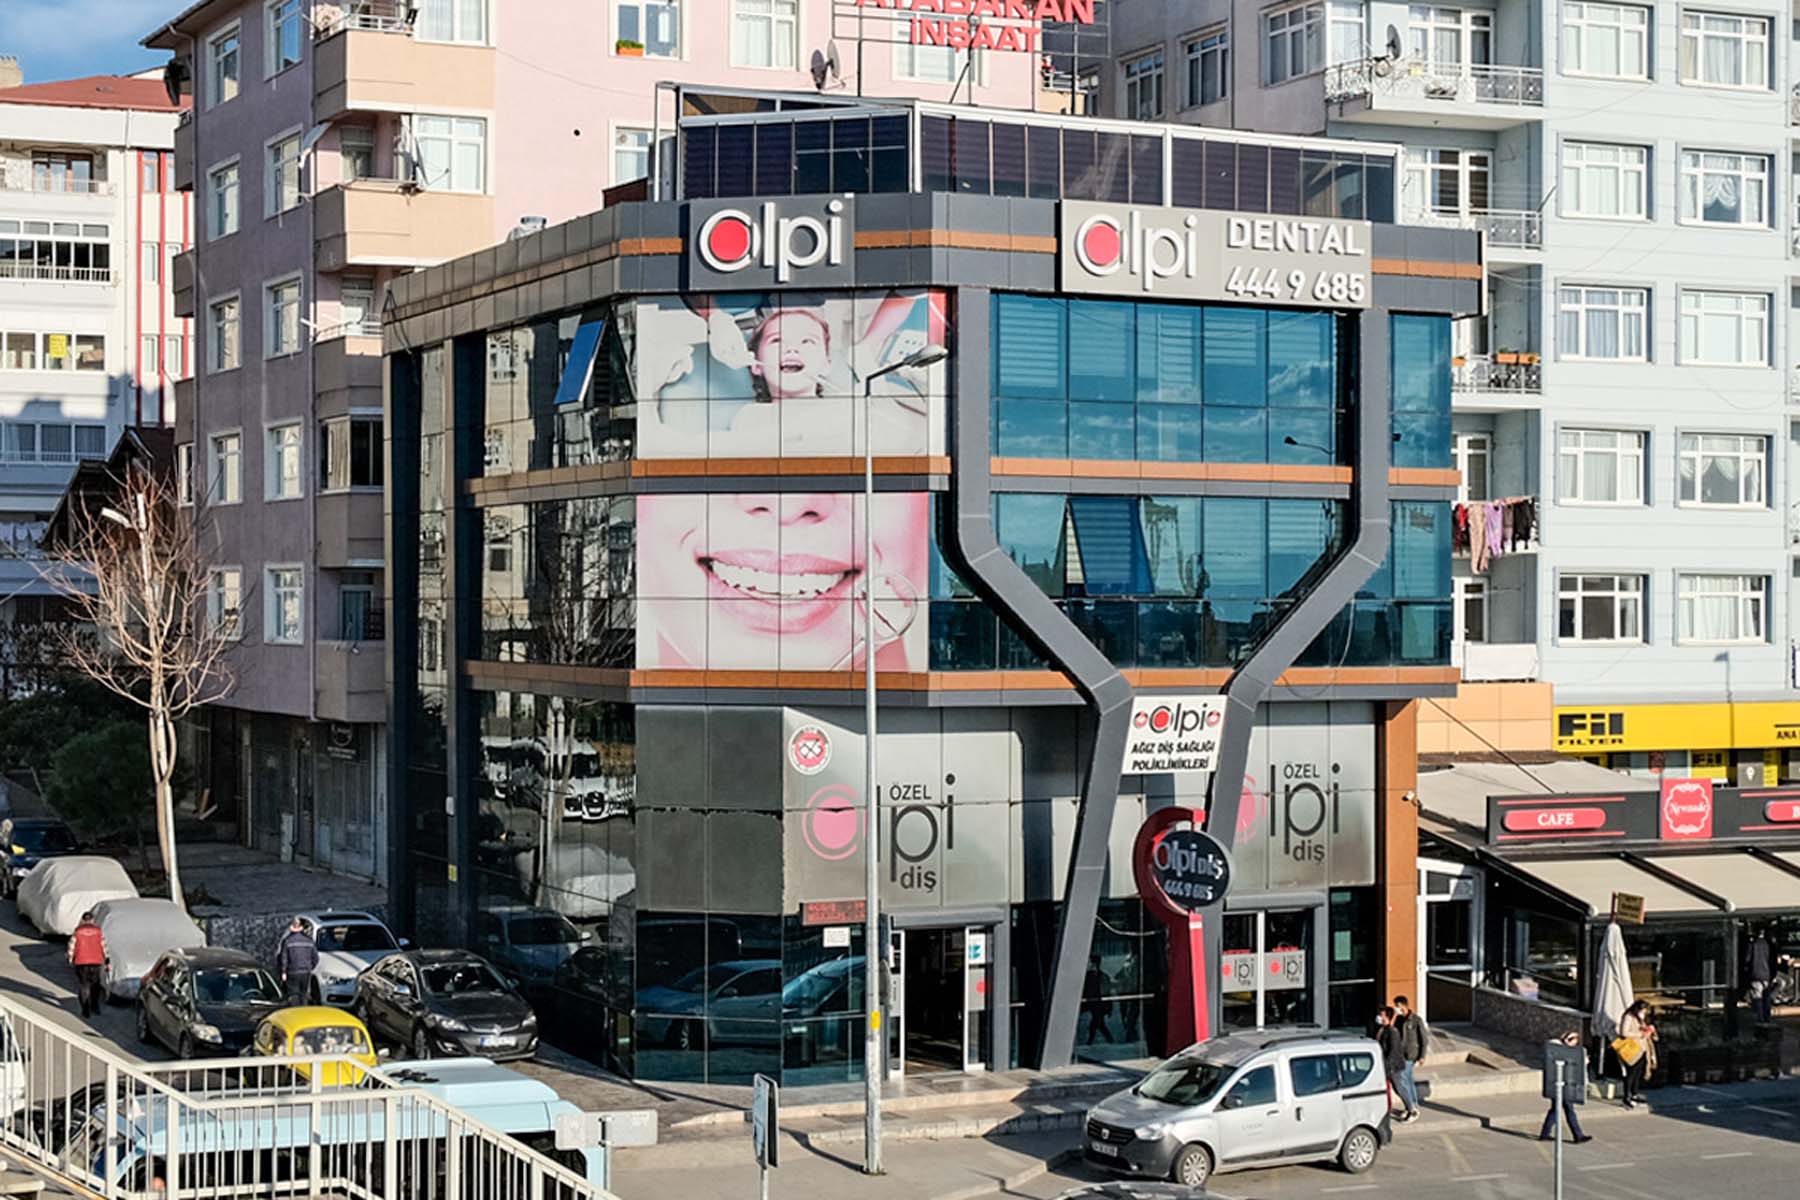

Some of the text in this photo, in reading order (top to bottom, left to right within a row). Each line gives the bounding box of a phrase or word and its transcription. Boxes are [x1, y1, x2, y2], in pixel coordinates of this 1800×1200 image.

[854, 0, 1094, 24] BAKAN
[911, 18, 1042, 53] İNŞAAT
[1227, 217, 1365, 256] DENTAL
[1225, 266, 1366, 303] 444 9 685
[1283, 762, 1321, 779] ÖZEL
[889, 784, 932, 801] ÖZEL
[1537, 813, 1575, 826] CAFE
[1292, 840, 1326, 865] diş
[900, 866, 937, 892] diş
